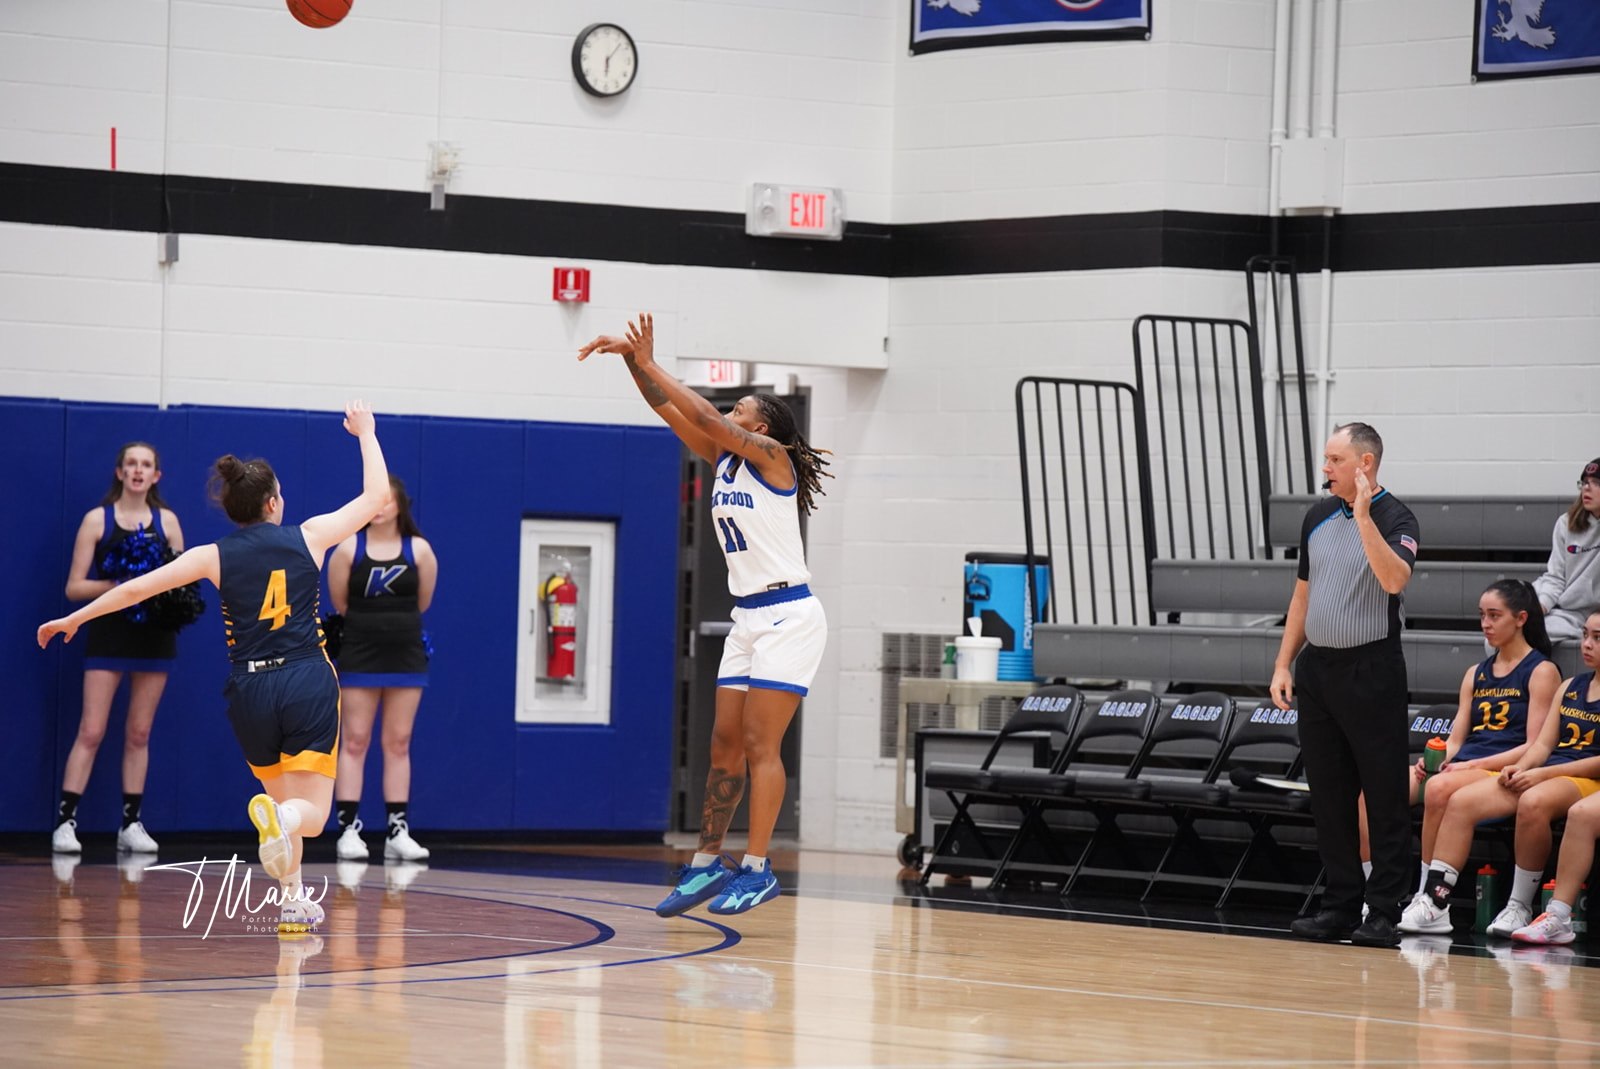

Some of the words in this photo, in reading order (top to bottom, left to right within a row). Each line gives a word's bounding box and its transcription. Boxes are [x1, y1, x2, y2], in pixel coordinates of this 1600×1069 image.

[790, 192, 826, 228] EXIT
[718, 517, 748, 553] 11
[364, 565, 408, 598] K
[258, 569, 291, 631] 4
[1021, 696, 1072, 712] EAGLES
[1098, 701, 1147, 717] EAGLES
[1171, 704, 1222, 721] EAGLES
